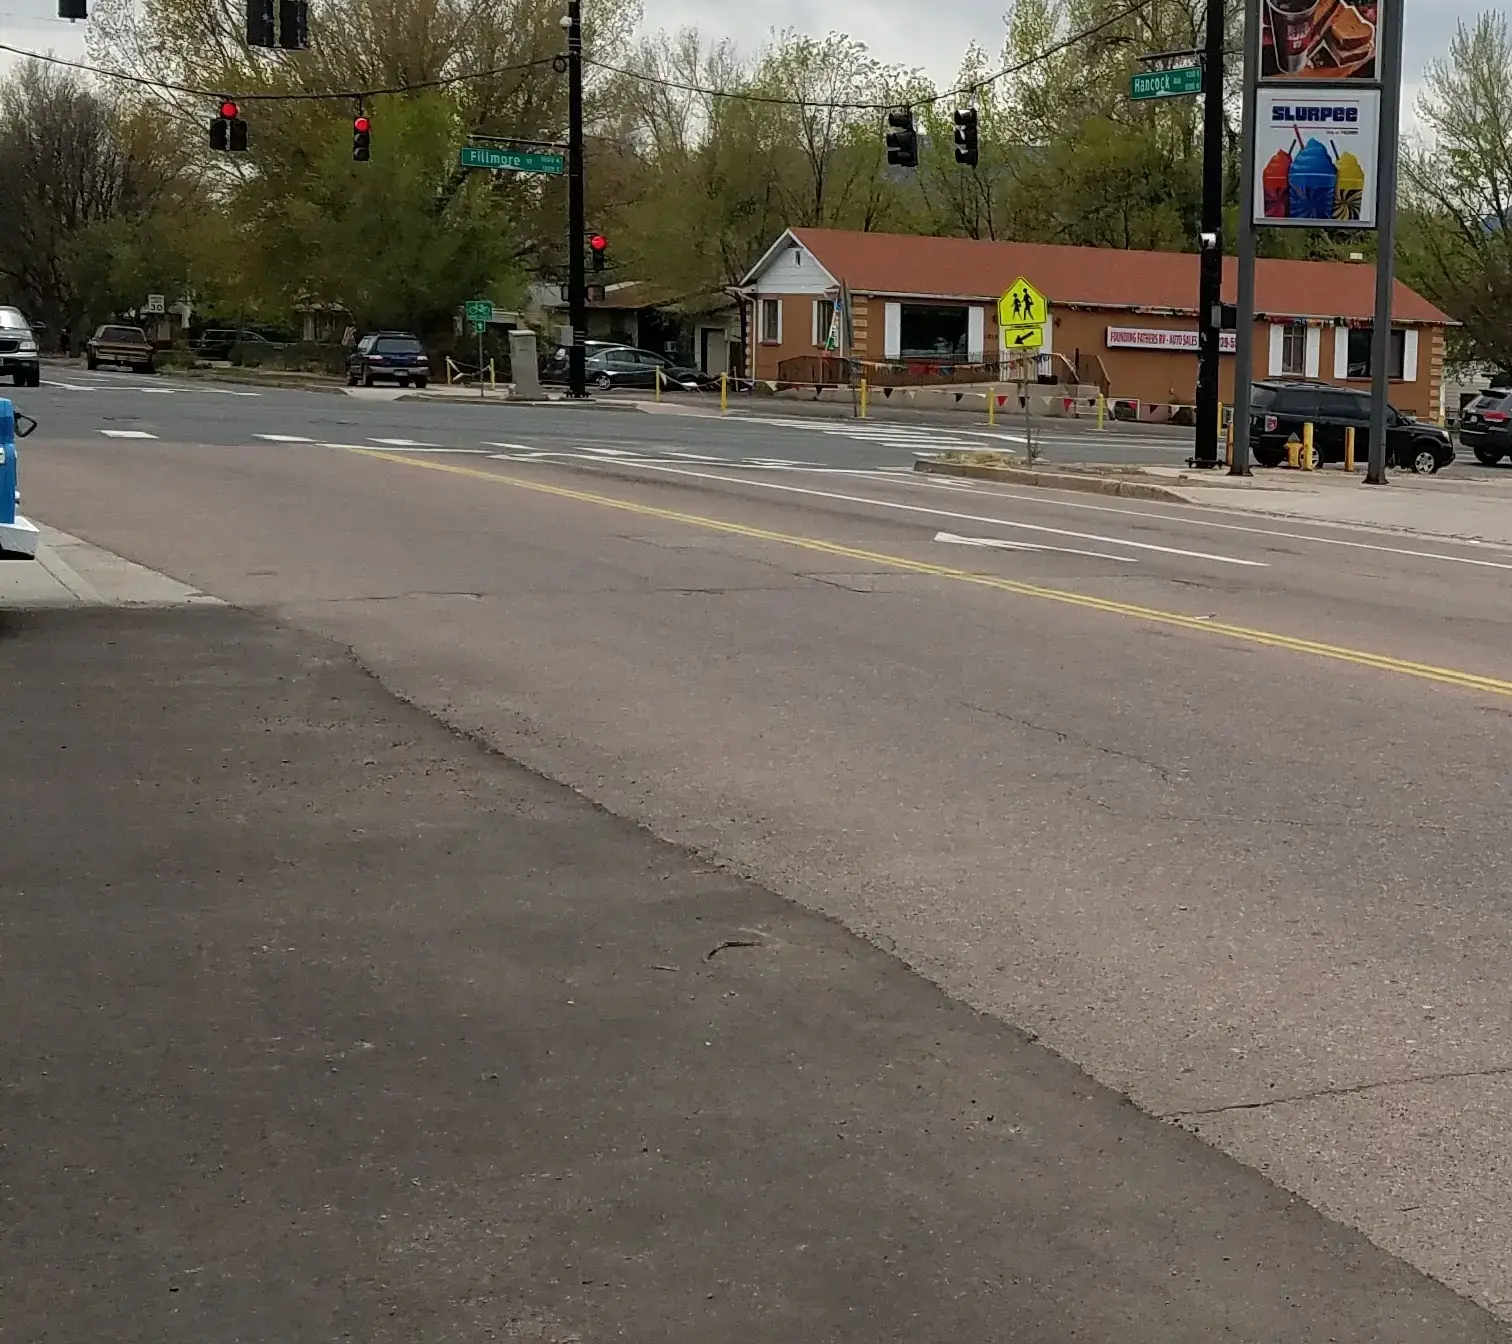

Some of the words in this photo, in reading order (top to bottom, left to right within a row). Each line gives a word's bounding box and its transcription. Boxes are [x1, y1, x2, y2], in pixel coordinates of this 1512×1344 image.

[1134, 73, 1171, 93] Hancock
[470, 150, 521, 166] Fillmore
[1110, 331, 1137, 344] FOUNDING
[1169, 334, 1182, 346] AUTO
[1182, 334, 1198, 346] SALES
